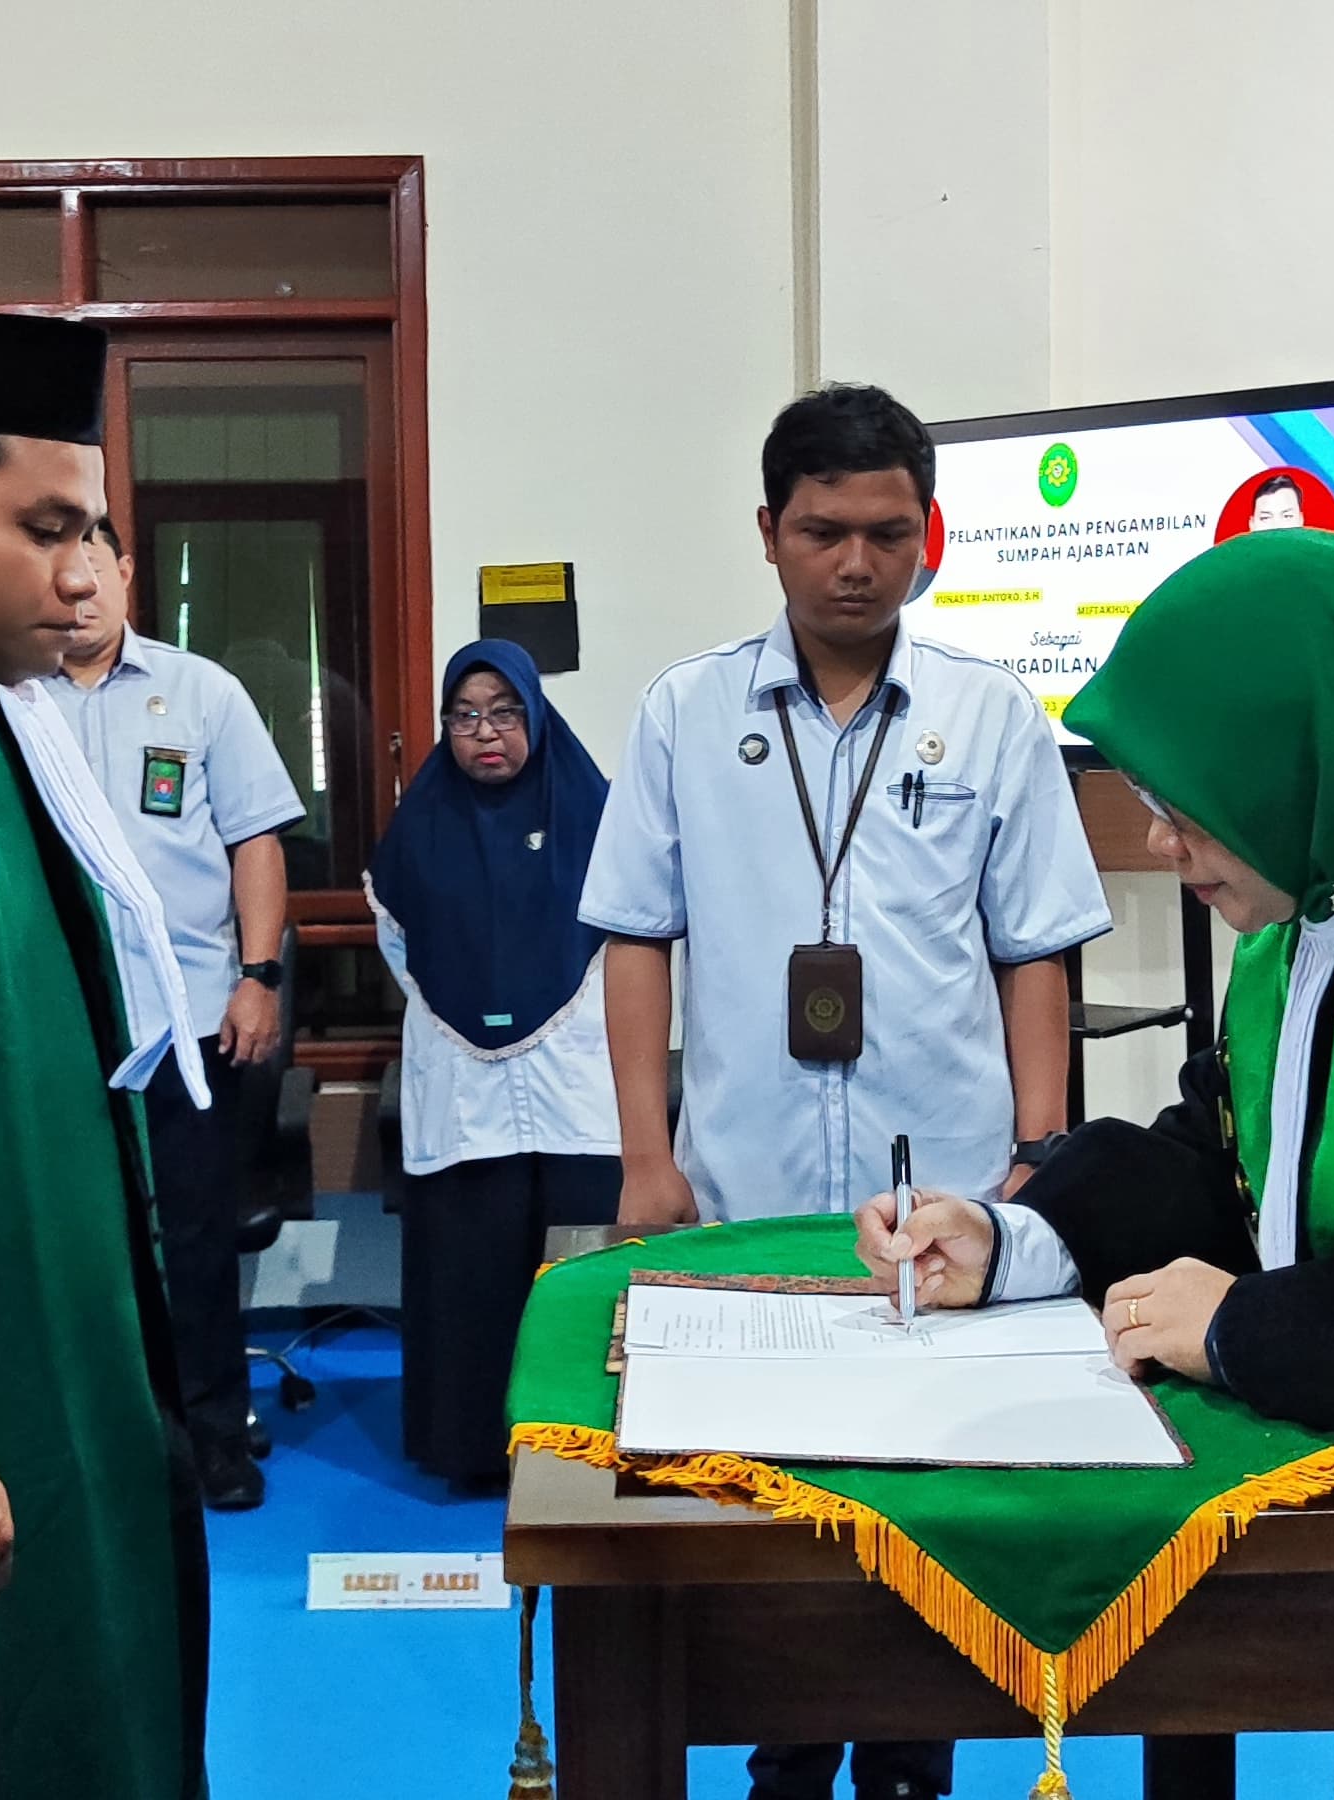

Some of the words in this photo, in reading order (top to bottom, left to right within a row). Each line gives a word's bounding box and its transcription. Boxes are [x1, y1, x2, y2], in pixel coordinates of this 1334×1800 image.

[948, 525, 1042, 544] PELANTIKAN
[1047, 522, 1080, 538] DAN
[1086, 514, 1207, 534] PENGAMBILAN
[997, 547, 1061, 563] SUMPAH
[1067, 542, 1149, 562] AJABATAN
[1030, 631, 1083, 651] Sebagai
